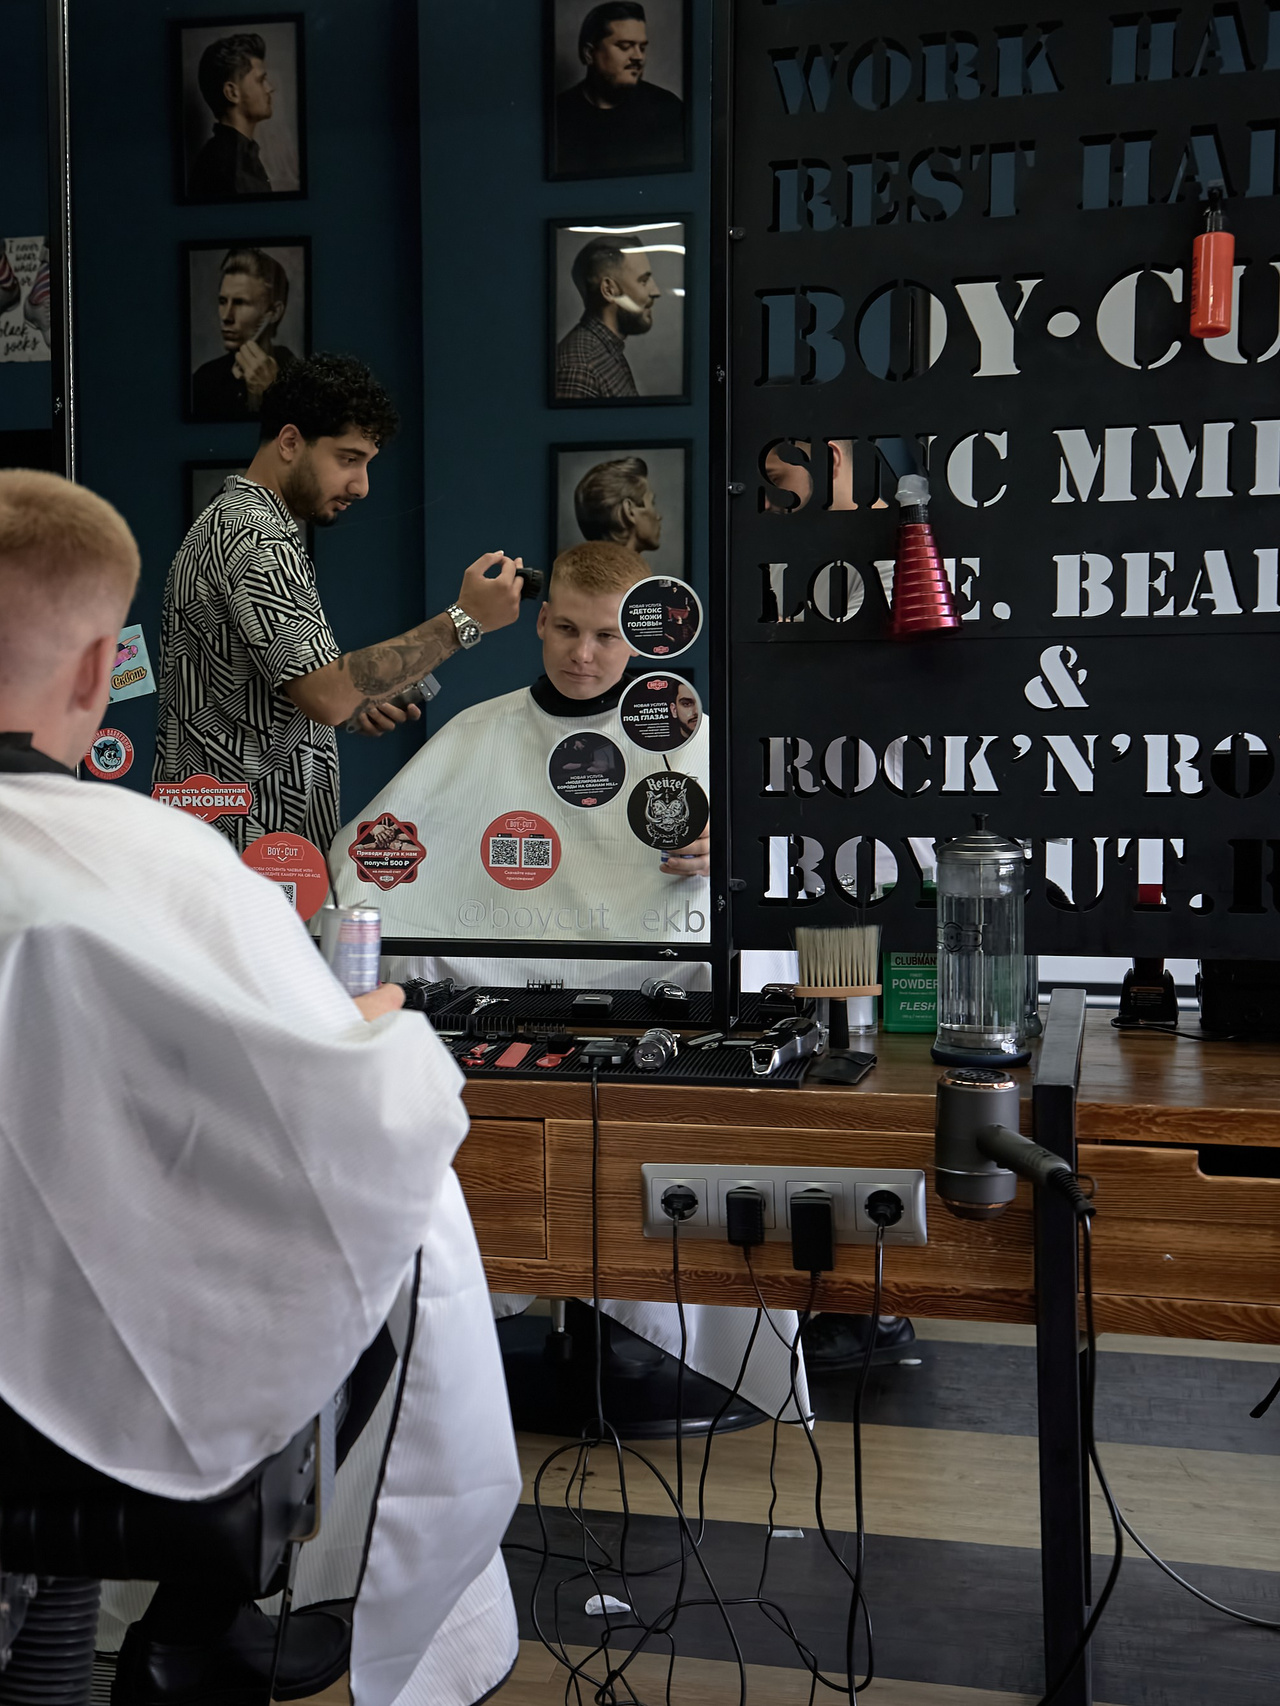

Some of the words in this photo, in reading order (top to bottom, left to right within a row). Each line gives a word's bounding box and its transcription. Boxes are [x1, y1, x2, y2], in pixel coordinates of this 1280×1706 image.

[767, 20, 1064, 114] WORK
[767, 140, 1037, 232] REST
[628, 607, 663, 616] «ДЕТОКС
[639, 613, 663, 621] КОЖИ
[627, 620, 663, 628] ГОЛОВЫ»
[1024, 644, 1090, 709] &
[640, 713, 669, 721] ГЛАЗА»
[201, 786, 246, 794] бесплатная
[159, 795, 247, 807] ПАРКОВКА
[756, 833, 1215, 914] BOYUT.
[894, 956, 937, 966] CLUBMAN
[899, 1001, 937, 1011] FLESH
